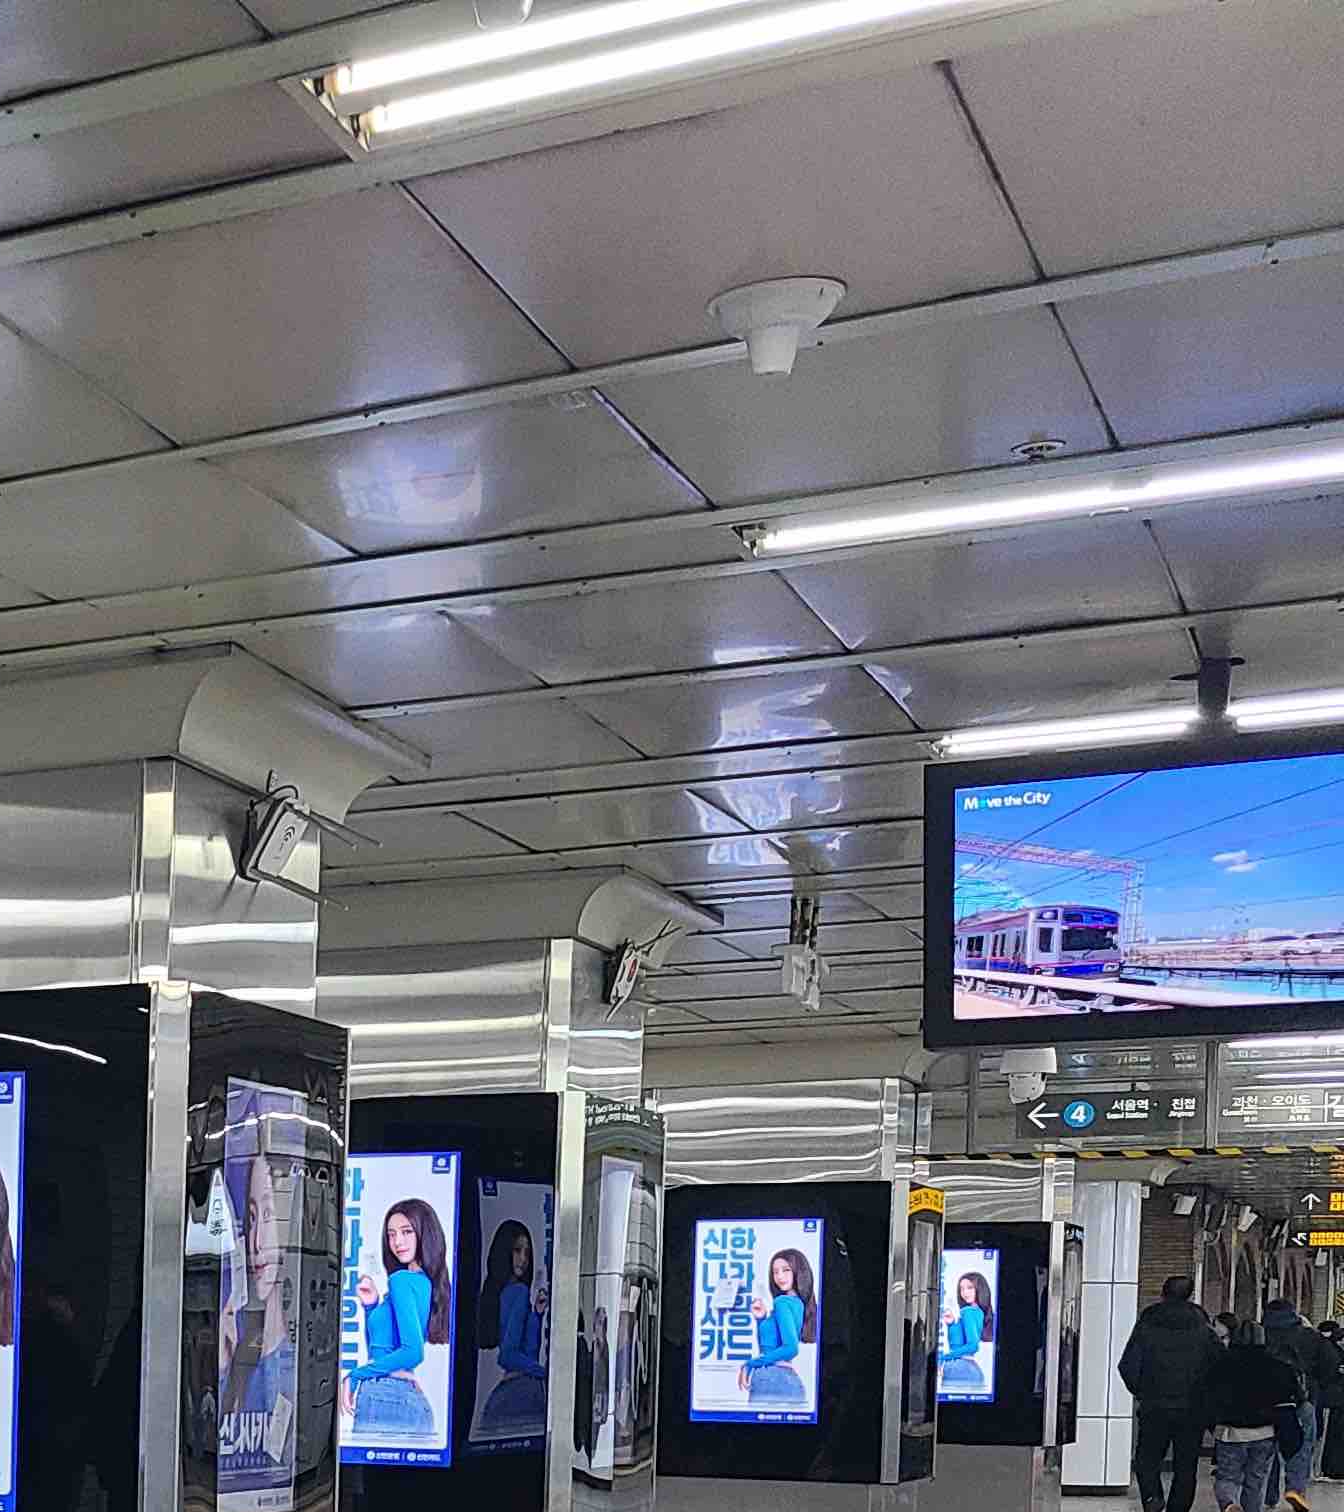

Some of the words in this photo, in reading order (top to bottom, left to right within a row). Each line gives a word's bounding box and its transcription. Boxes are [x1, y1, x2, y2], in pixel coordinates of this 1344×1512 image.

[1023, 791, 1052, 805] City
[1070, 1104, 1086, 1123] 4
[1112, 1098, 1150, 1111] 서울역
[703, 1227, 756, 1261] 신한
[700, 1328, 753, 1361] 카드
